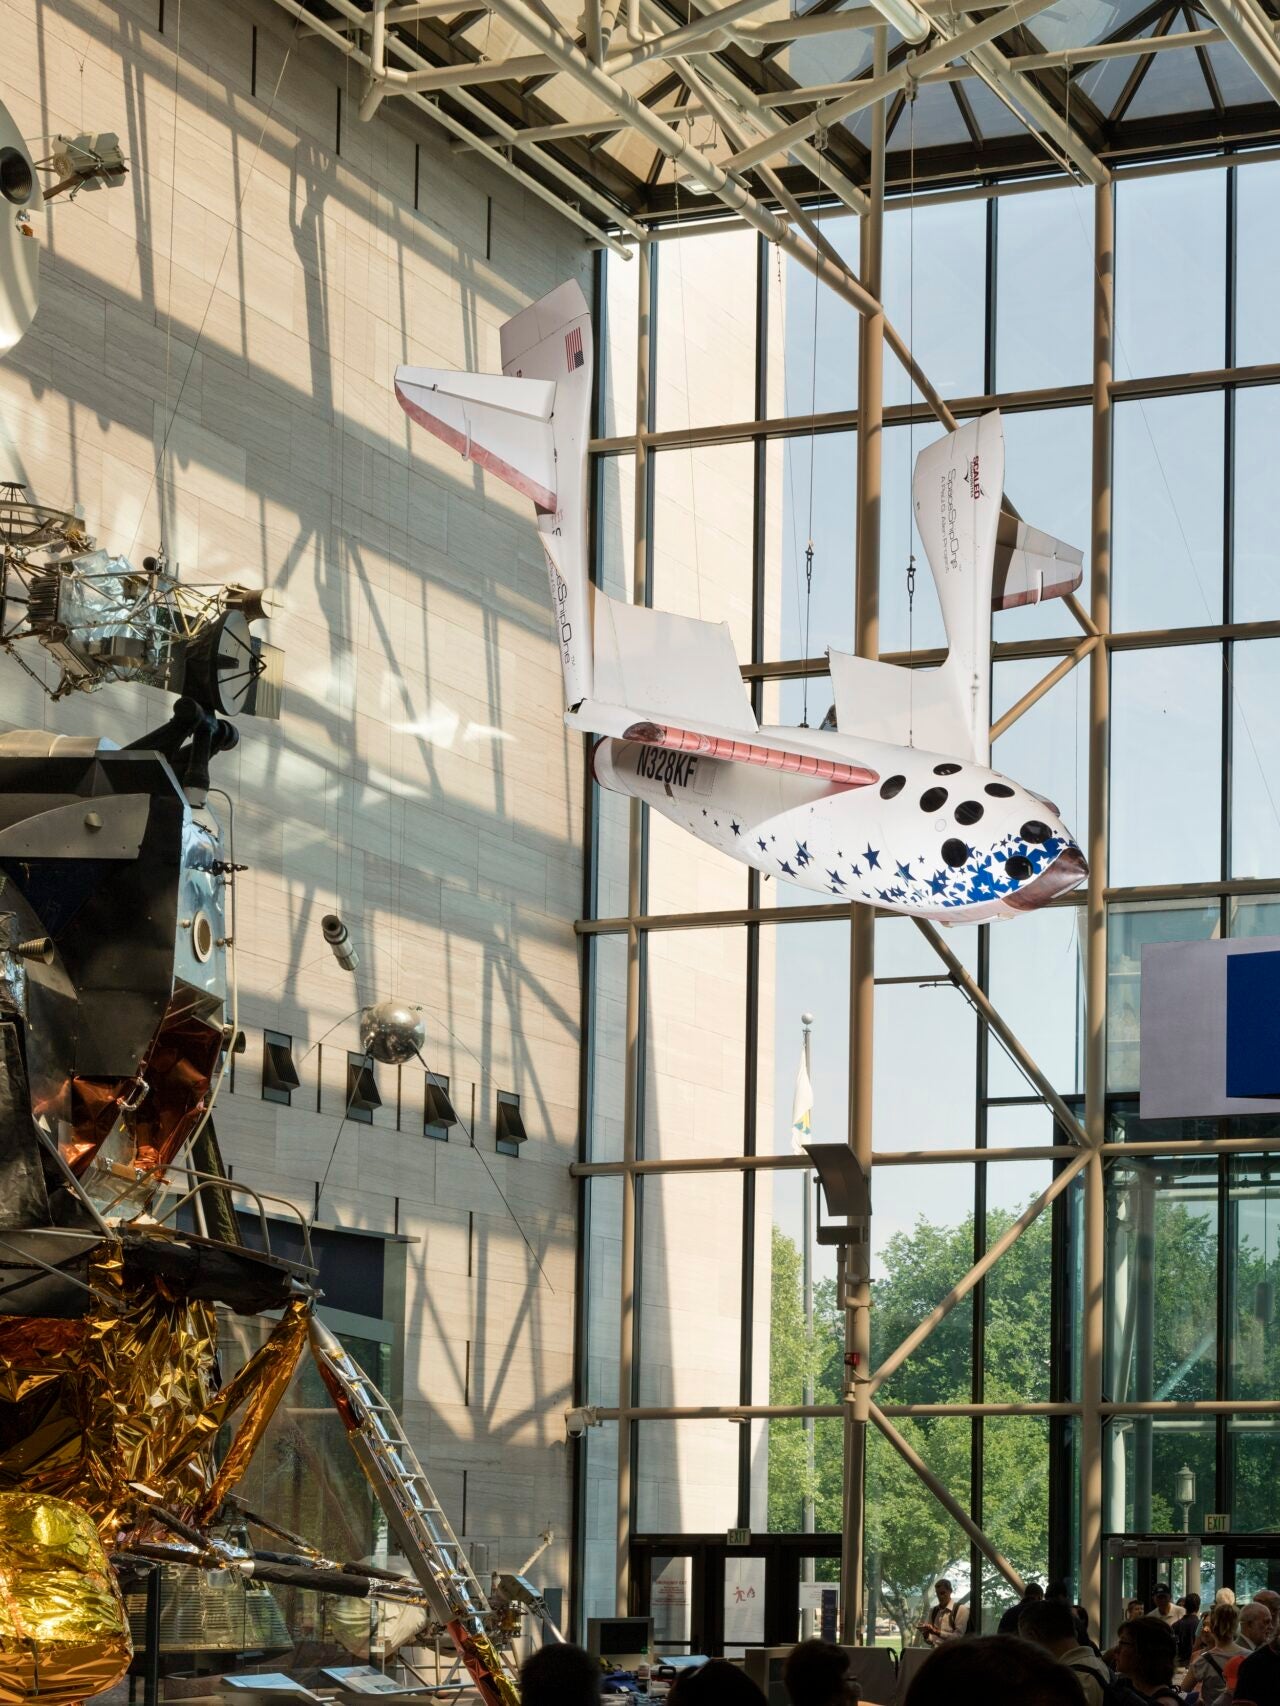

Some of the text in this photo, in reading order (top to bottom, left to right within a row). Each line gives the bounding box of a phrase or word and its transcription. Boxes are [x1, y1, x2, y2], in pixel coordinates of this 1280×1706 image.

[972, 455, 981, 500] SCALED
[947, 468, 960, 569] SpaceShipOne
[636, 745, 698, 787] N328KF
[729, 1530, 747, 1544] EXIT
[1207, 1516, 1226, 1531] EXIT
